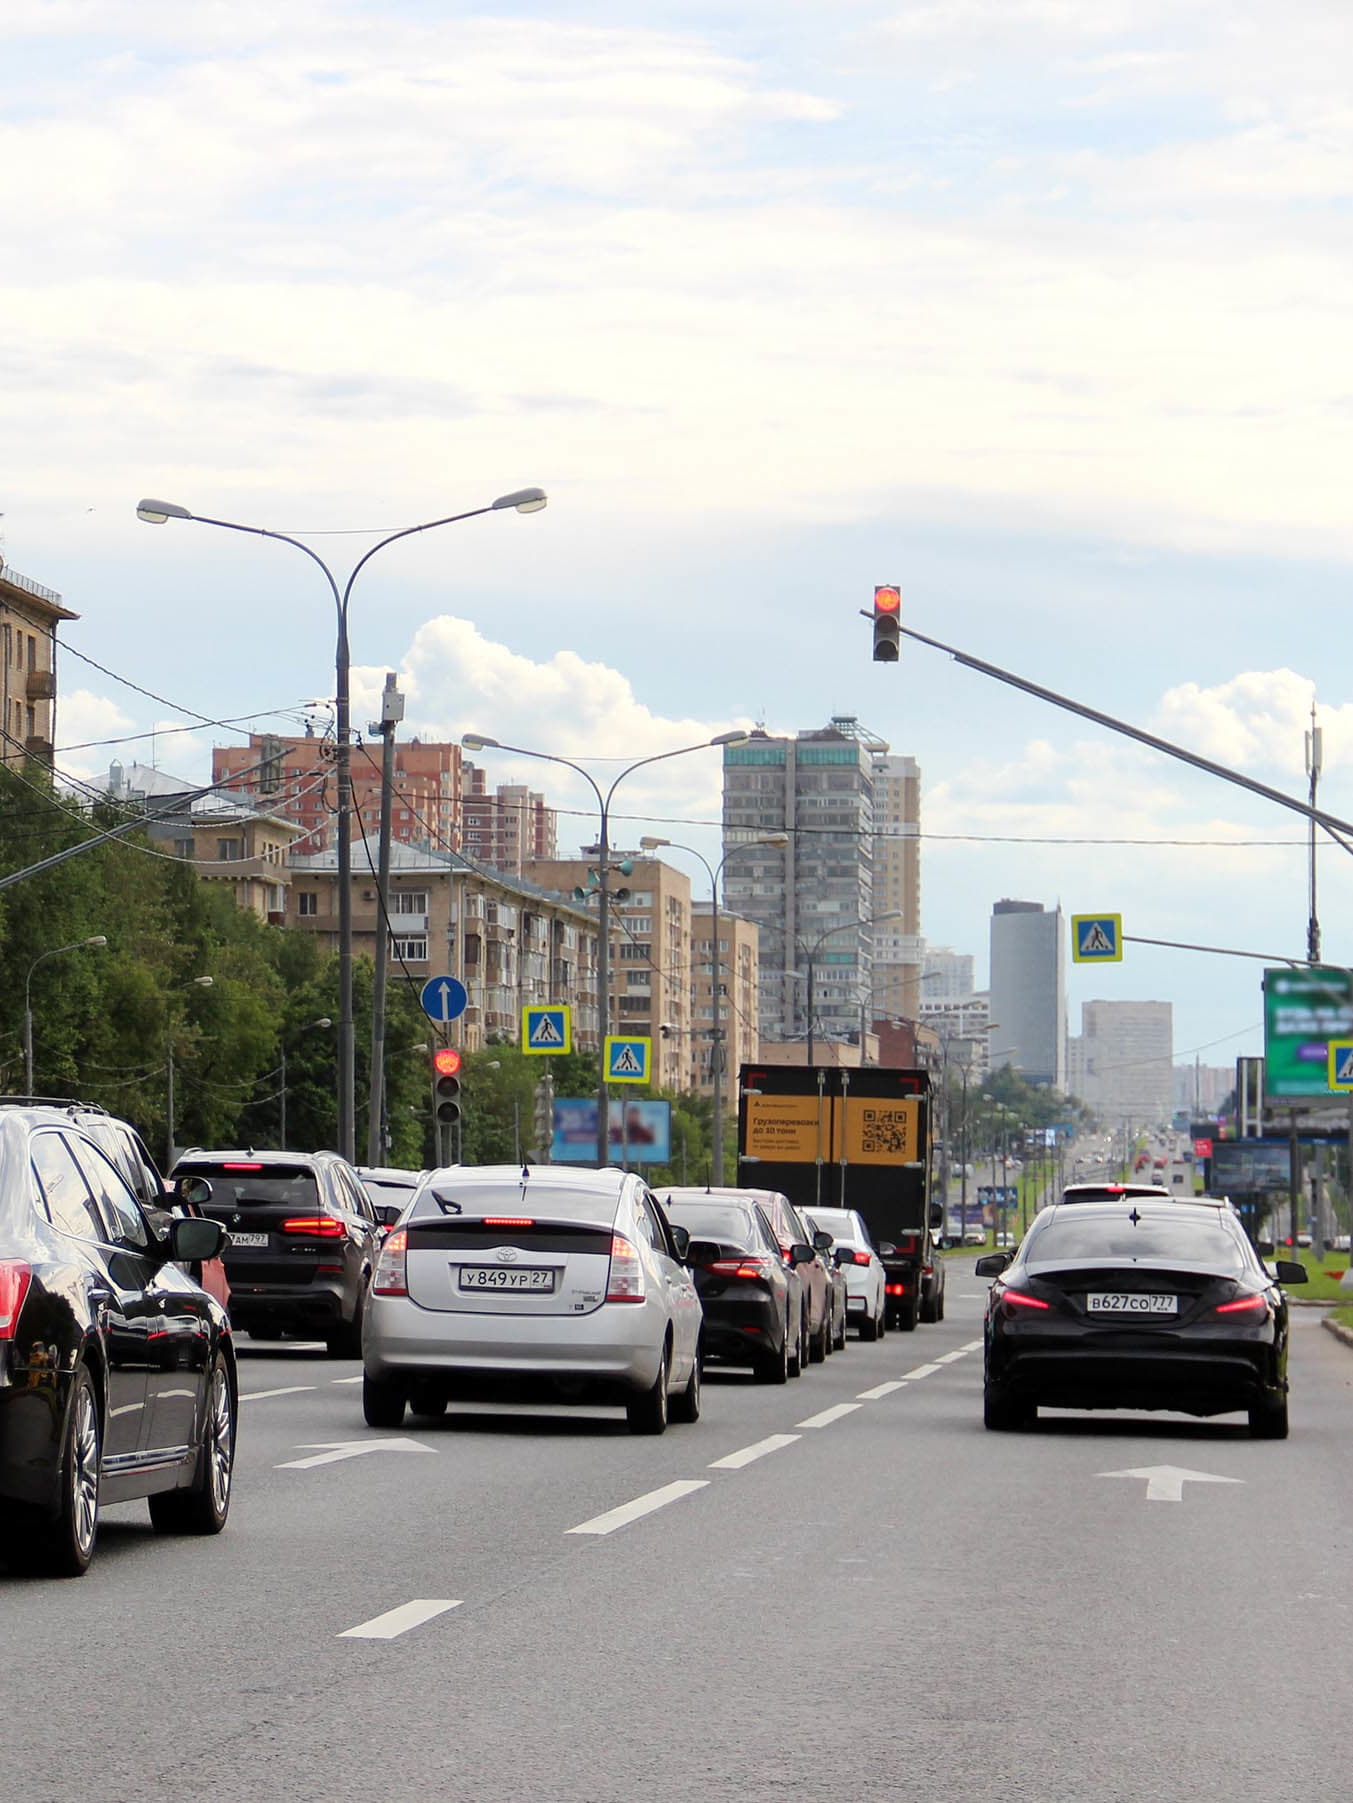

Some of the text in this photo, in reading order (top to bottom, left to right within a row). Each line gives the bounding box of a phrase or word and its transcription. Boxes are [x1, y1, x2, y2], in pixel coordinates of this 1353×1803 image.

[467, 1271, 548, 1286] У849УР 27
[1092, 1295, 1174, 1310] В627СО 777
